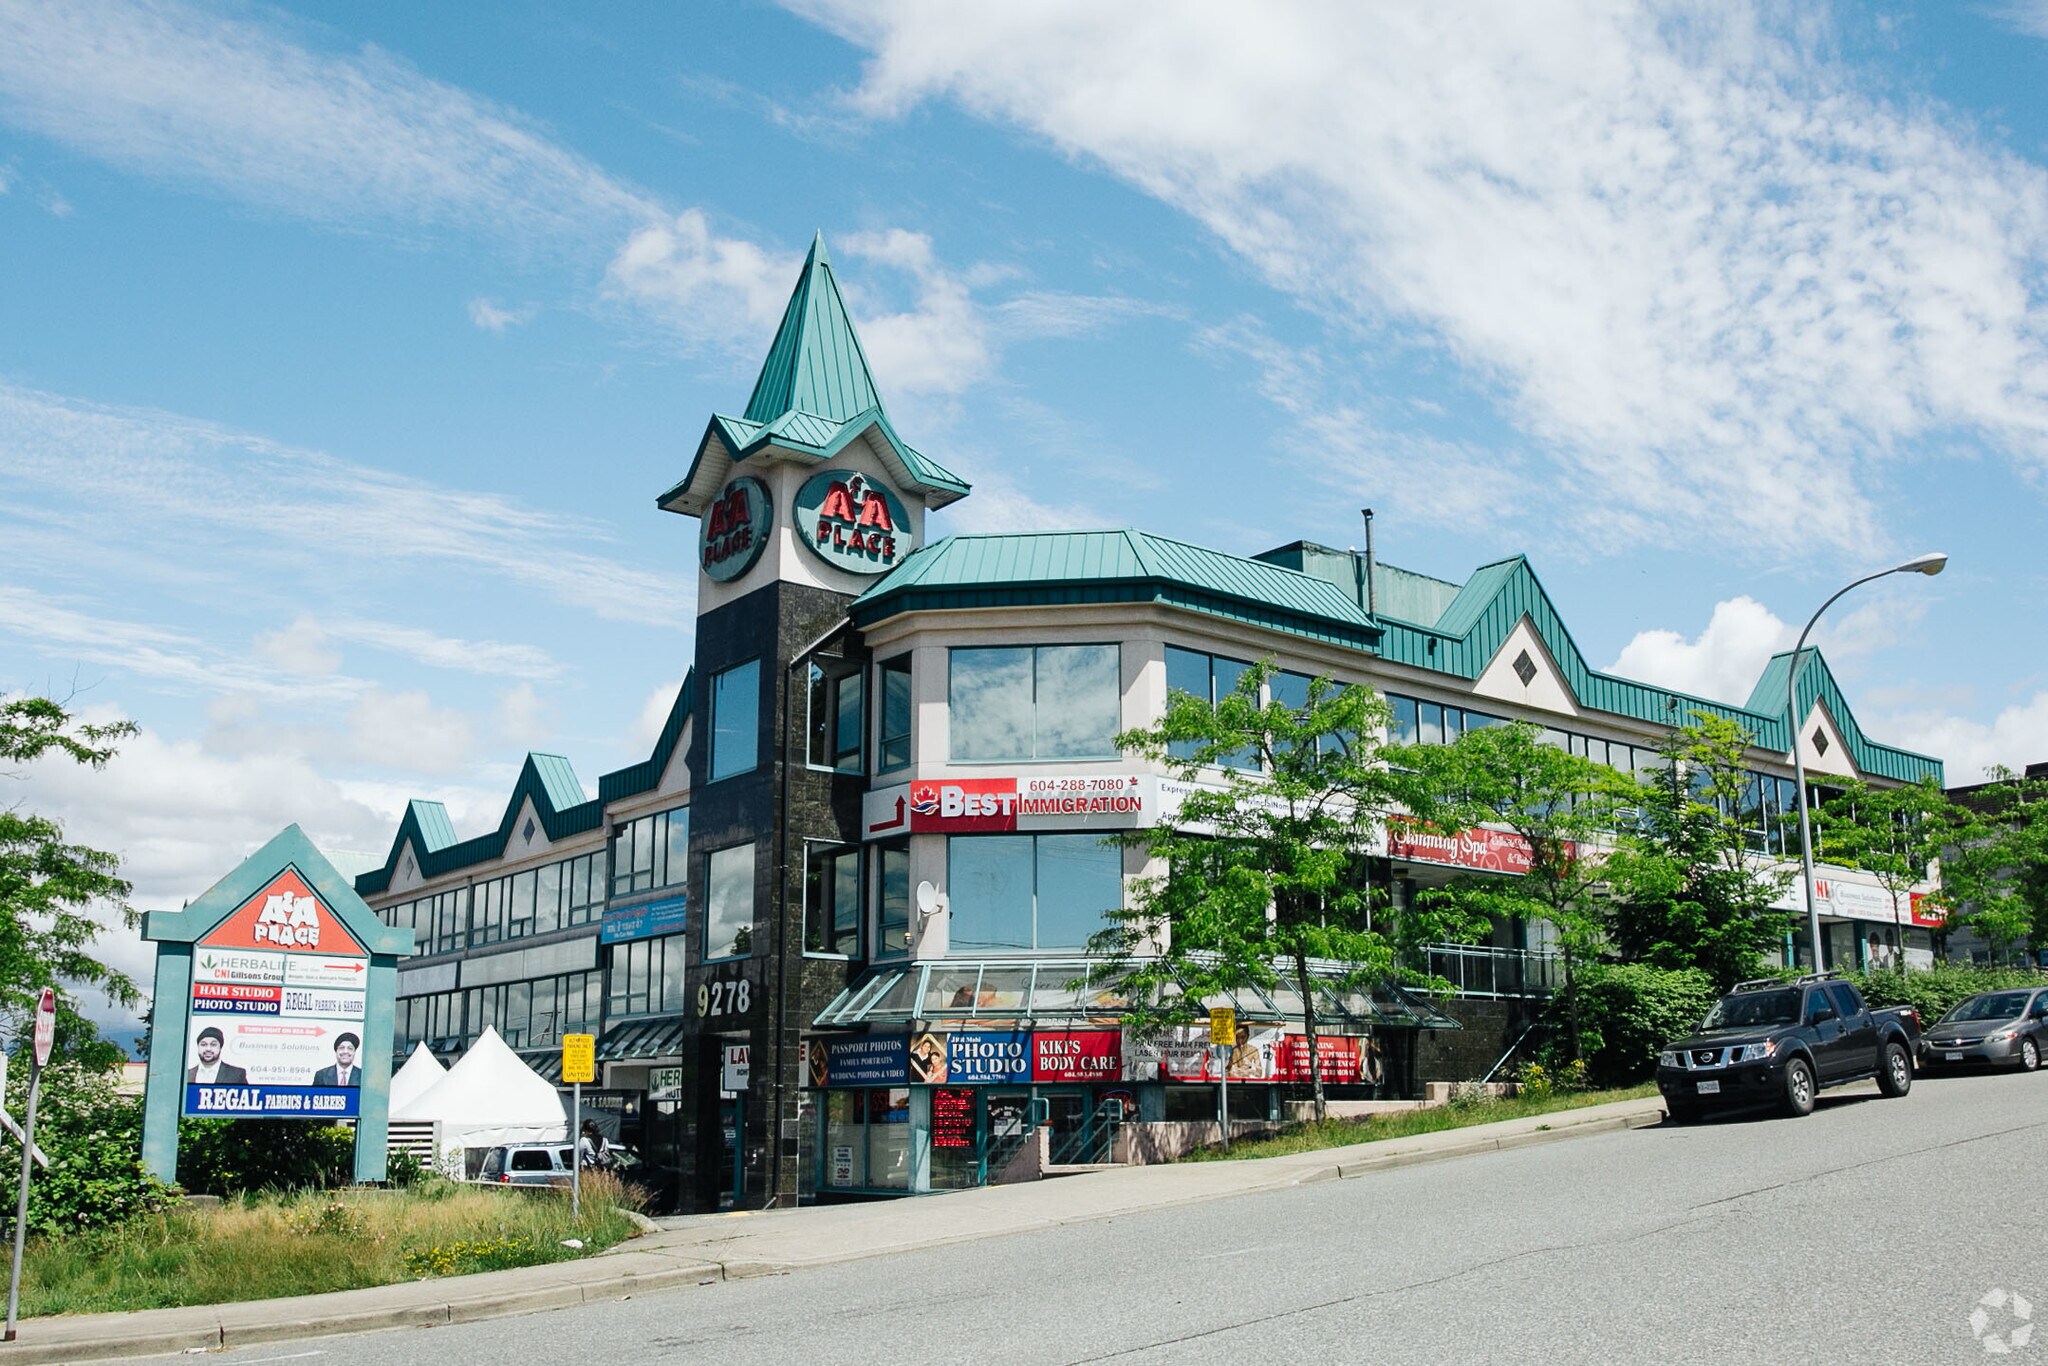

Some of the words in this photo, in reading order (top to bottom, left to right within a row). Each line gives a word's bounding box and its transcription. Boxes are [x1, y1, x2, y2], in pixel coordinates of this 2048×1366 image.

[817, 520, 896, 558] PLACE
[704, 526, 753, 568] PLACE
[1029, 779, 1124, 792] 604-288-7080
[1461, 829, 1488, 862] Spa
[254, 923, 320, 947] PLACE
[200, 985, 229, 996] HAIR
[231, 987, 275, 999] STUDIO
[697, 979, 750, 1018] 9278
[194, 998, 234, 1010] PHOTO
[235, 1000, 278, 1012] STUDIO
[285, 992, 313, 1011] REGAL
[238, 1041, 278, 1050] Business
[281, 1042, 320, 1051] Solutions
[832, 1043, 868, 1054] PASSPORT
[870, 1040, 902, 1052] PHOTOS
[952, 1042, 1022, 1058] PHOTO
[1039, 1040, 1081, 1055] KIKI'S
[861, 1056, 893, 1065] PORTRAITS
[951, 1058, 1027, 1074] STUDIO
[1040, 1056, 1076, 1071] BODY
[1080, 1056, 1117, 1070] CARE
[857, 1070, 881, 1079] PHOTOS
[886, 1069, 905, 1078] VIDEO
[197, 1088, 262, 1111] REGAL
[264, 1094, 302, 1110] FABRICS
[303, 1096, 311, 1110] &
[312, 1095, 347, 1111] SAREES
